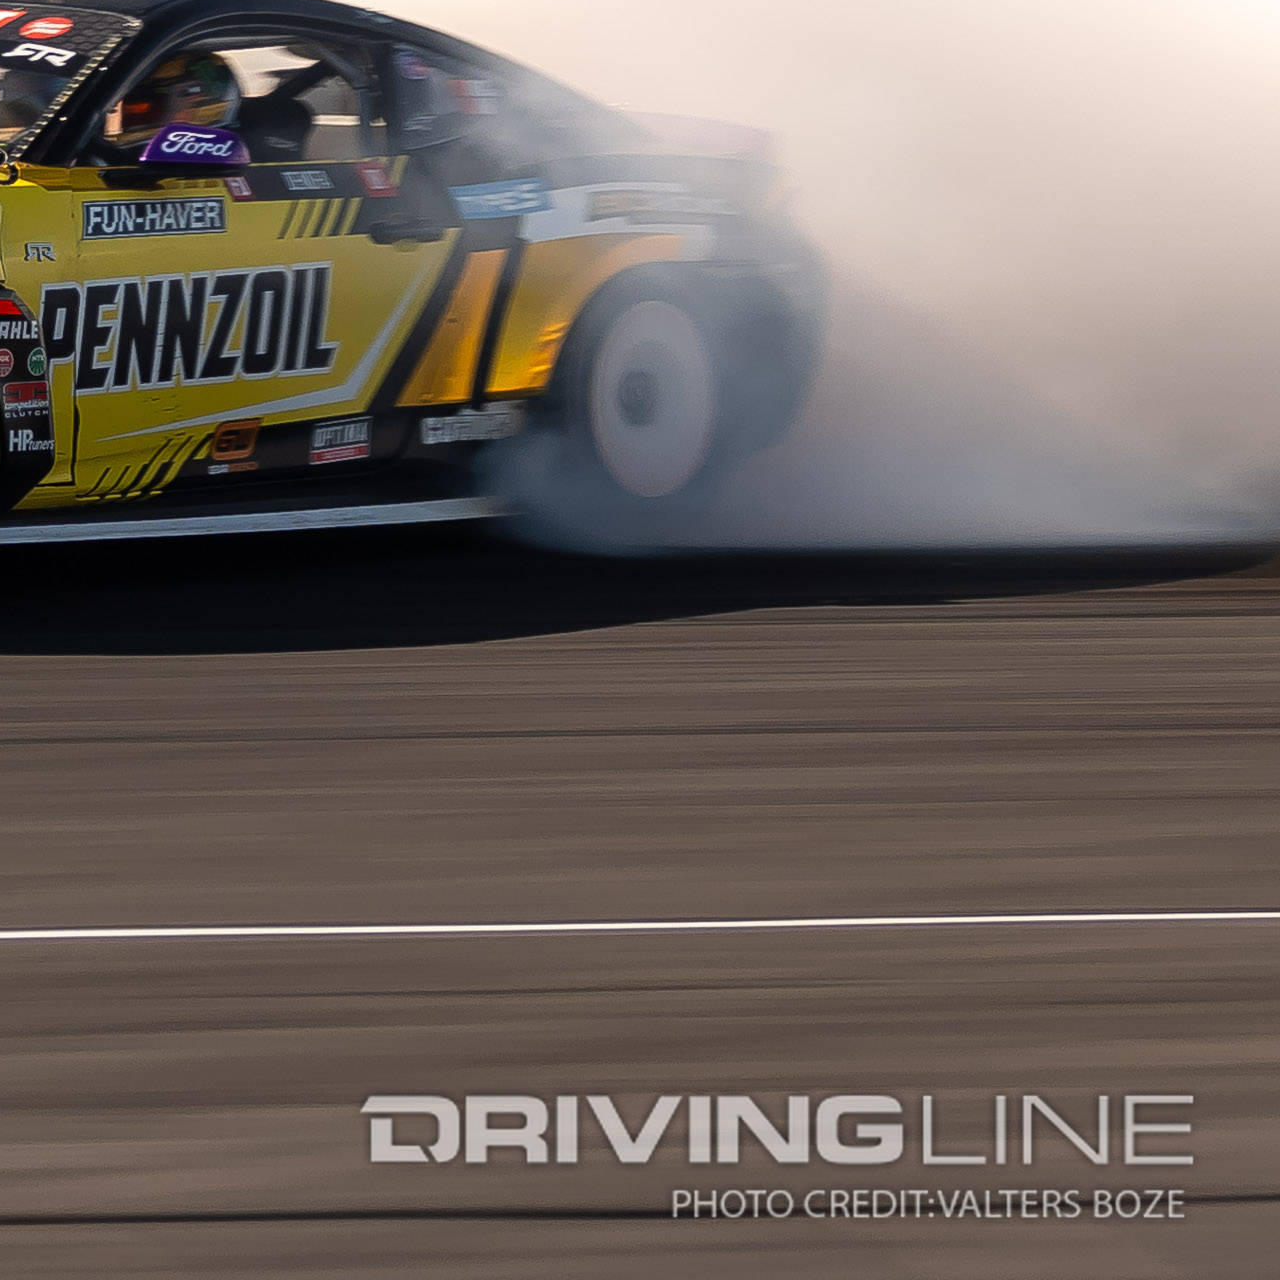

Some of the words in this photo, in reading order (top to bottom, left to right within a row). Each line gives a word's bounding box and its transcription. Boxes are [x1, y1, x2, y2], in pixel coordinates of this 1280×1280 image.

[161, 131, 234, 157] Ford
[86, 199, 224, 236] FUN-HAVER
[40, 261, 340, 396] PENNZOIL
